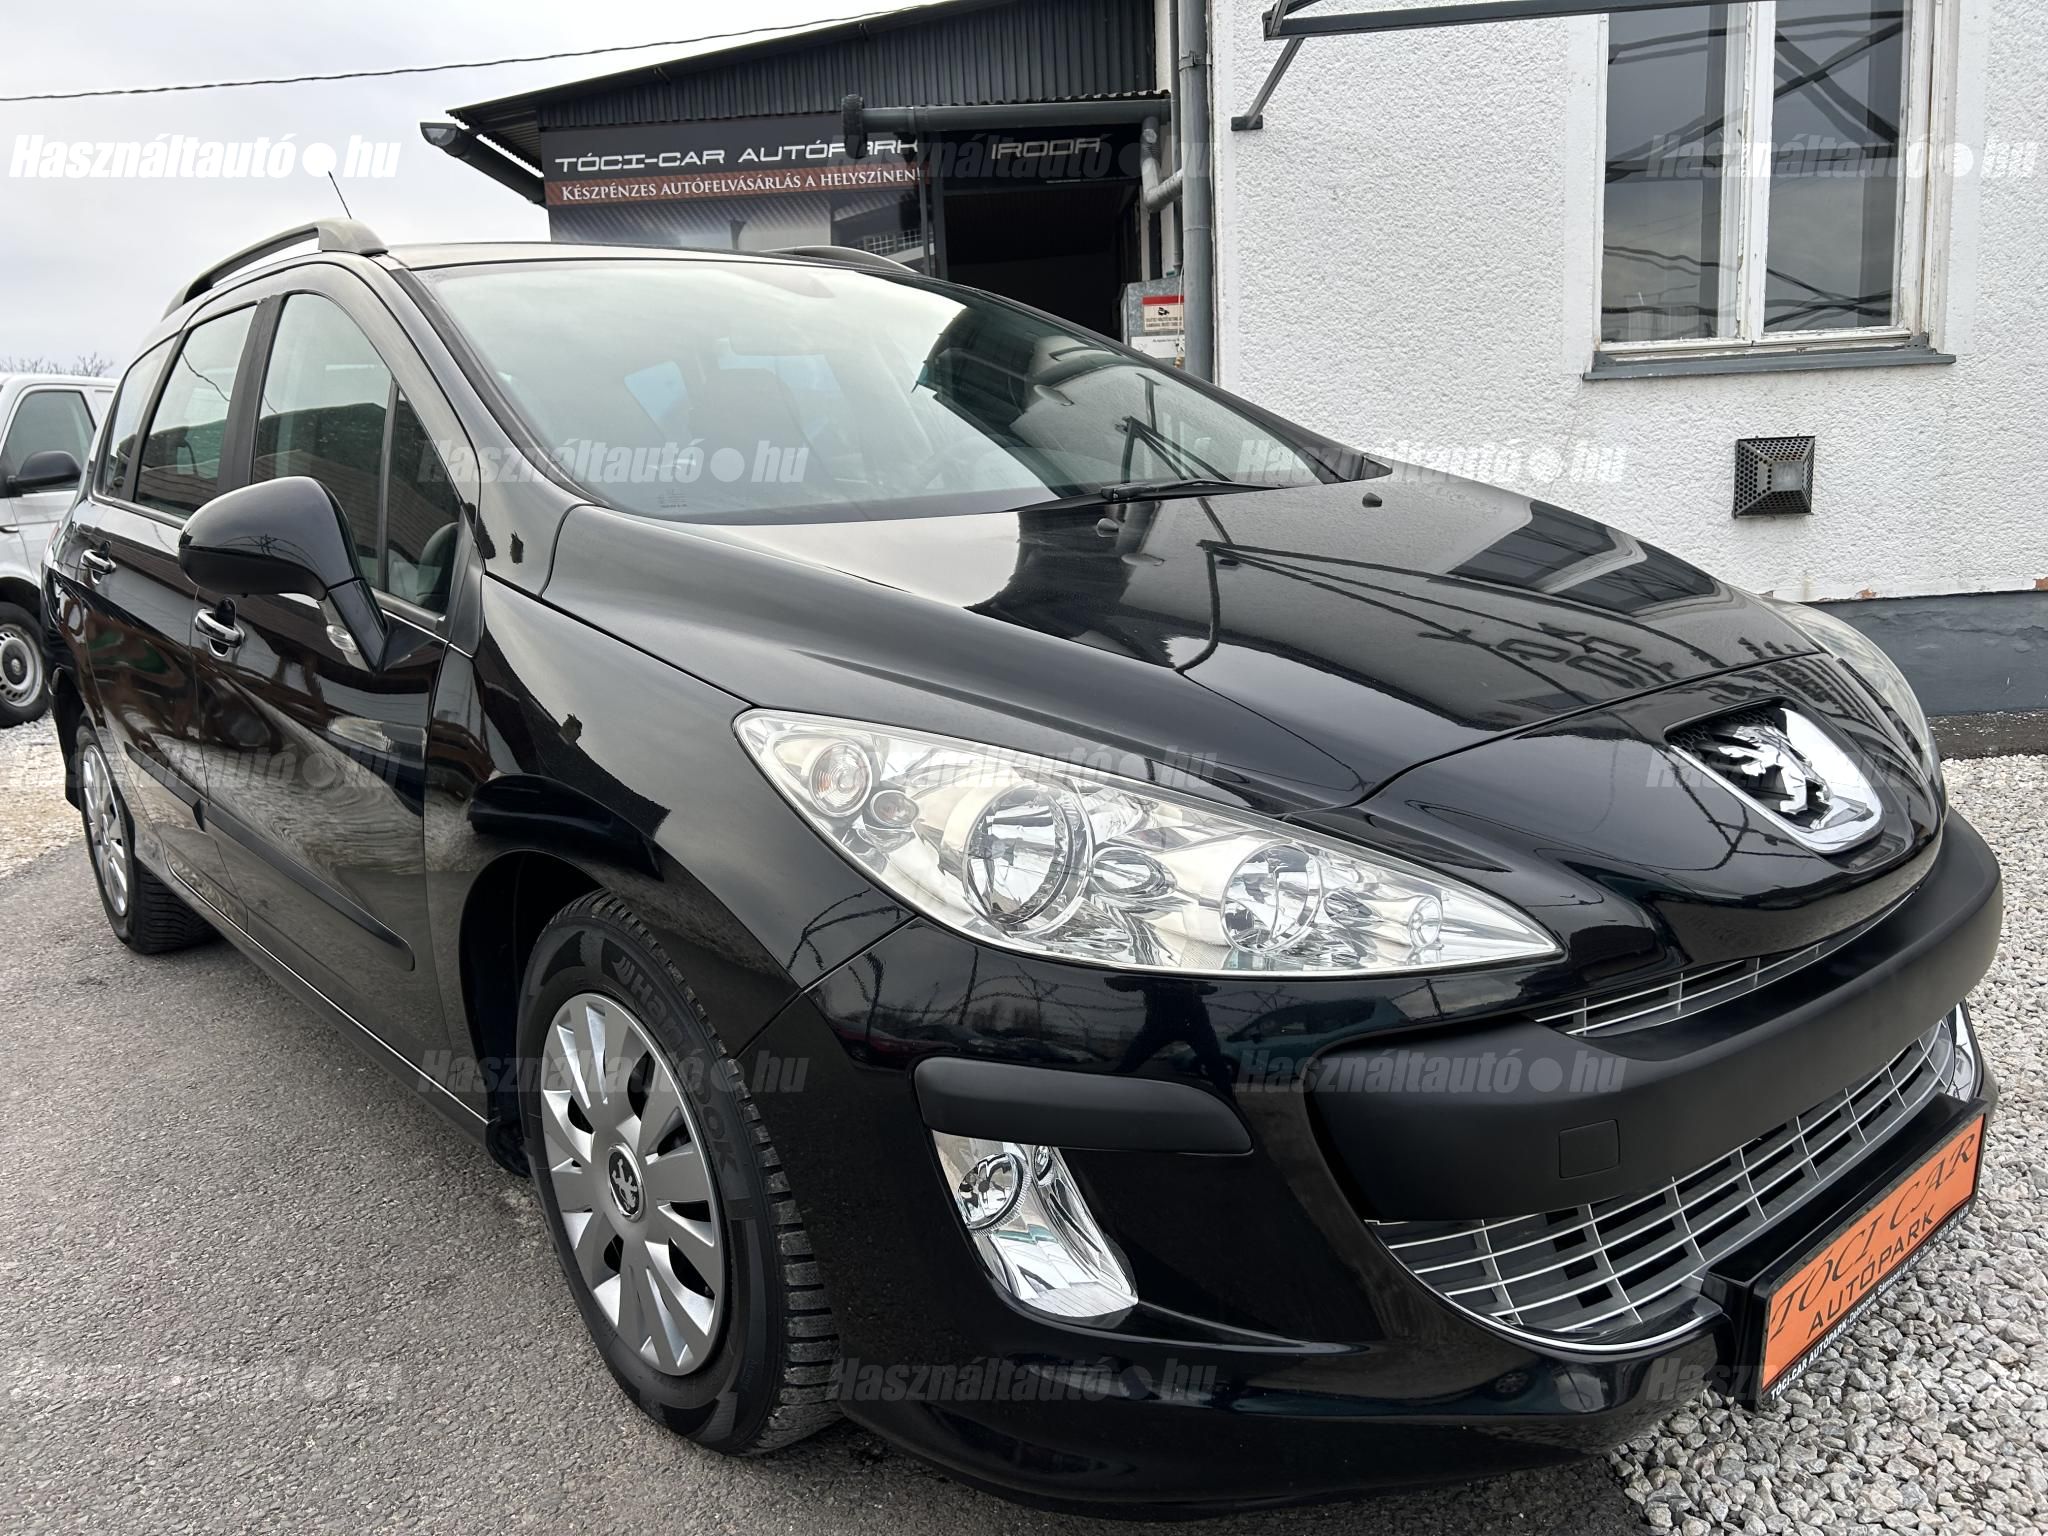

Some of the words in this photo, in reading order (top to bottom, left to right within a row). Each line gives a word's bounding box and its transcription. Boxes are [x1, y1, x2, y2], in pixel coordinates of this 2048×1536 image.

[555, 150, 725, 172] TÓCI-CAR
[991, 137, 1100, 159] IRODA
[562, 182, 657, 200] KÉSZPÉNZES
[661, 173, 801, 195] AUTÓFELVÁSÁRLÁS
[805, 176, 816, 187] A
[821, 167, 921, 186] HELYSZÍNEN!
[1889, 1132, 1977, 1230] CAR
[1807, 1204, 1935, 1340] AUTÓPARK
